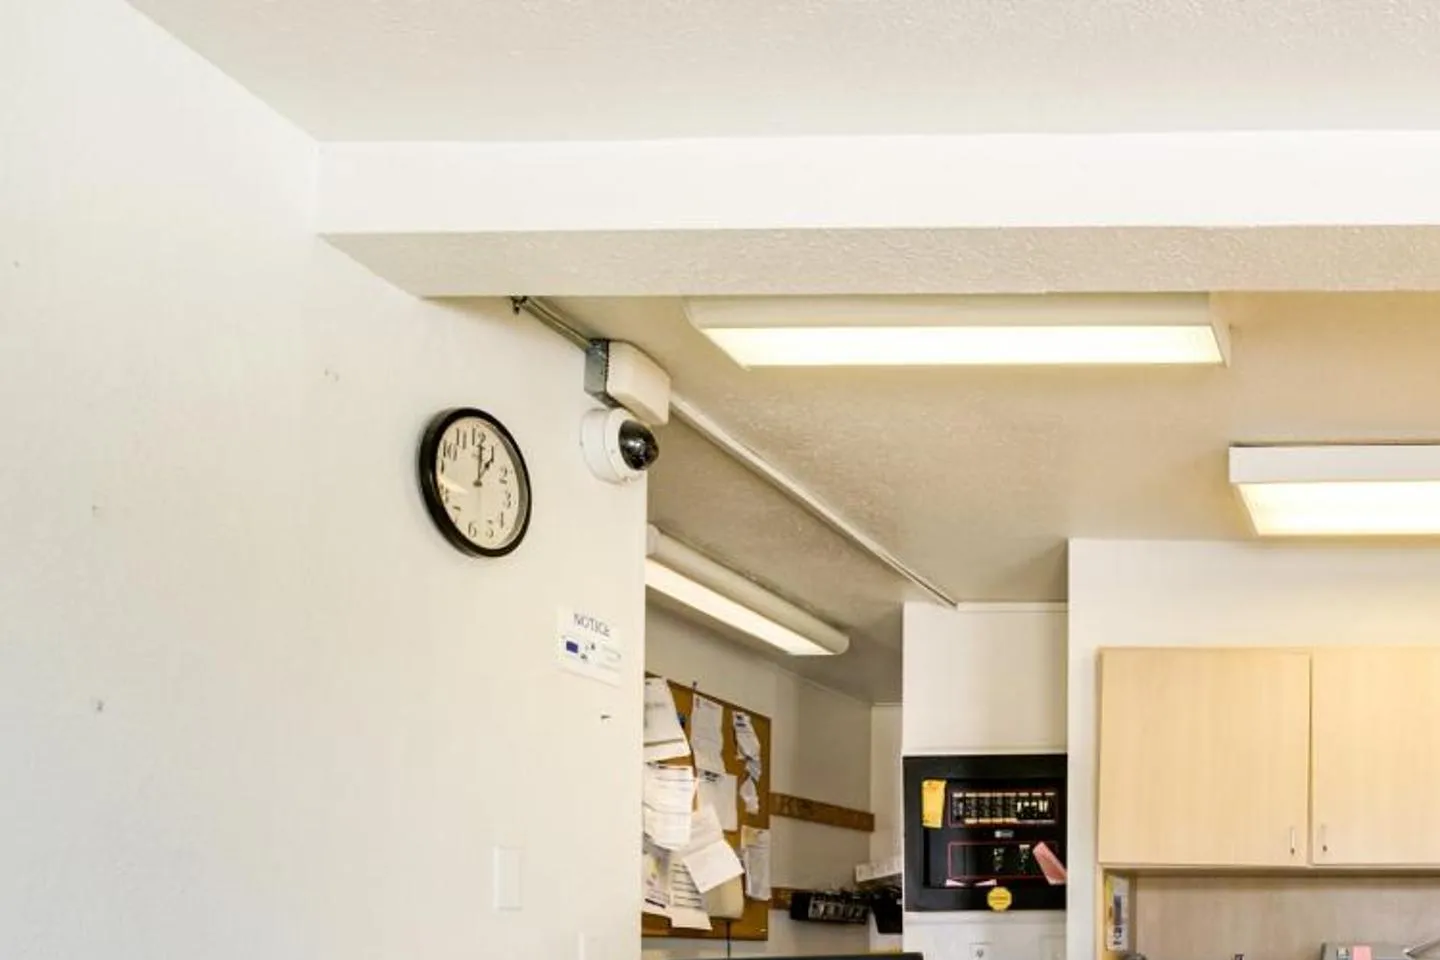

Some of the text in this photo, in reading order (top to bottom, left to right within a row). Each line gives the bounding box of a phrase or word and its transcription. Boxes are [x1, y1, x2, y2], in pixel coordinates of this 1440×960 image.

[456, 427, 467, 450] 11
[471, 427, 486, 449] 12
[442, 439, 458, 461] 10
[499, 466, 509, 485] 2
[467, 521, 478, 539] 6
[573, 613, 611, 637] NOTICE
